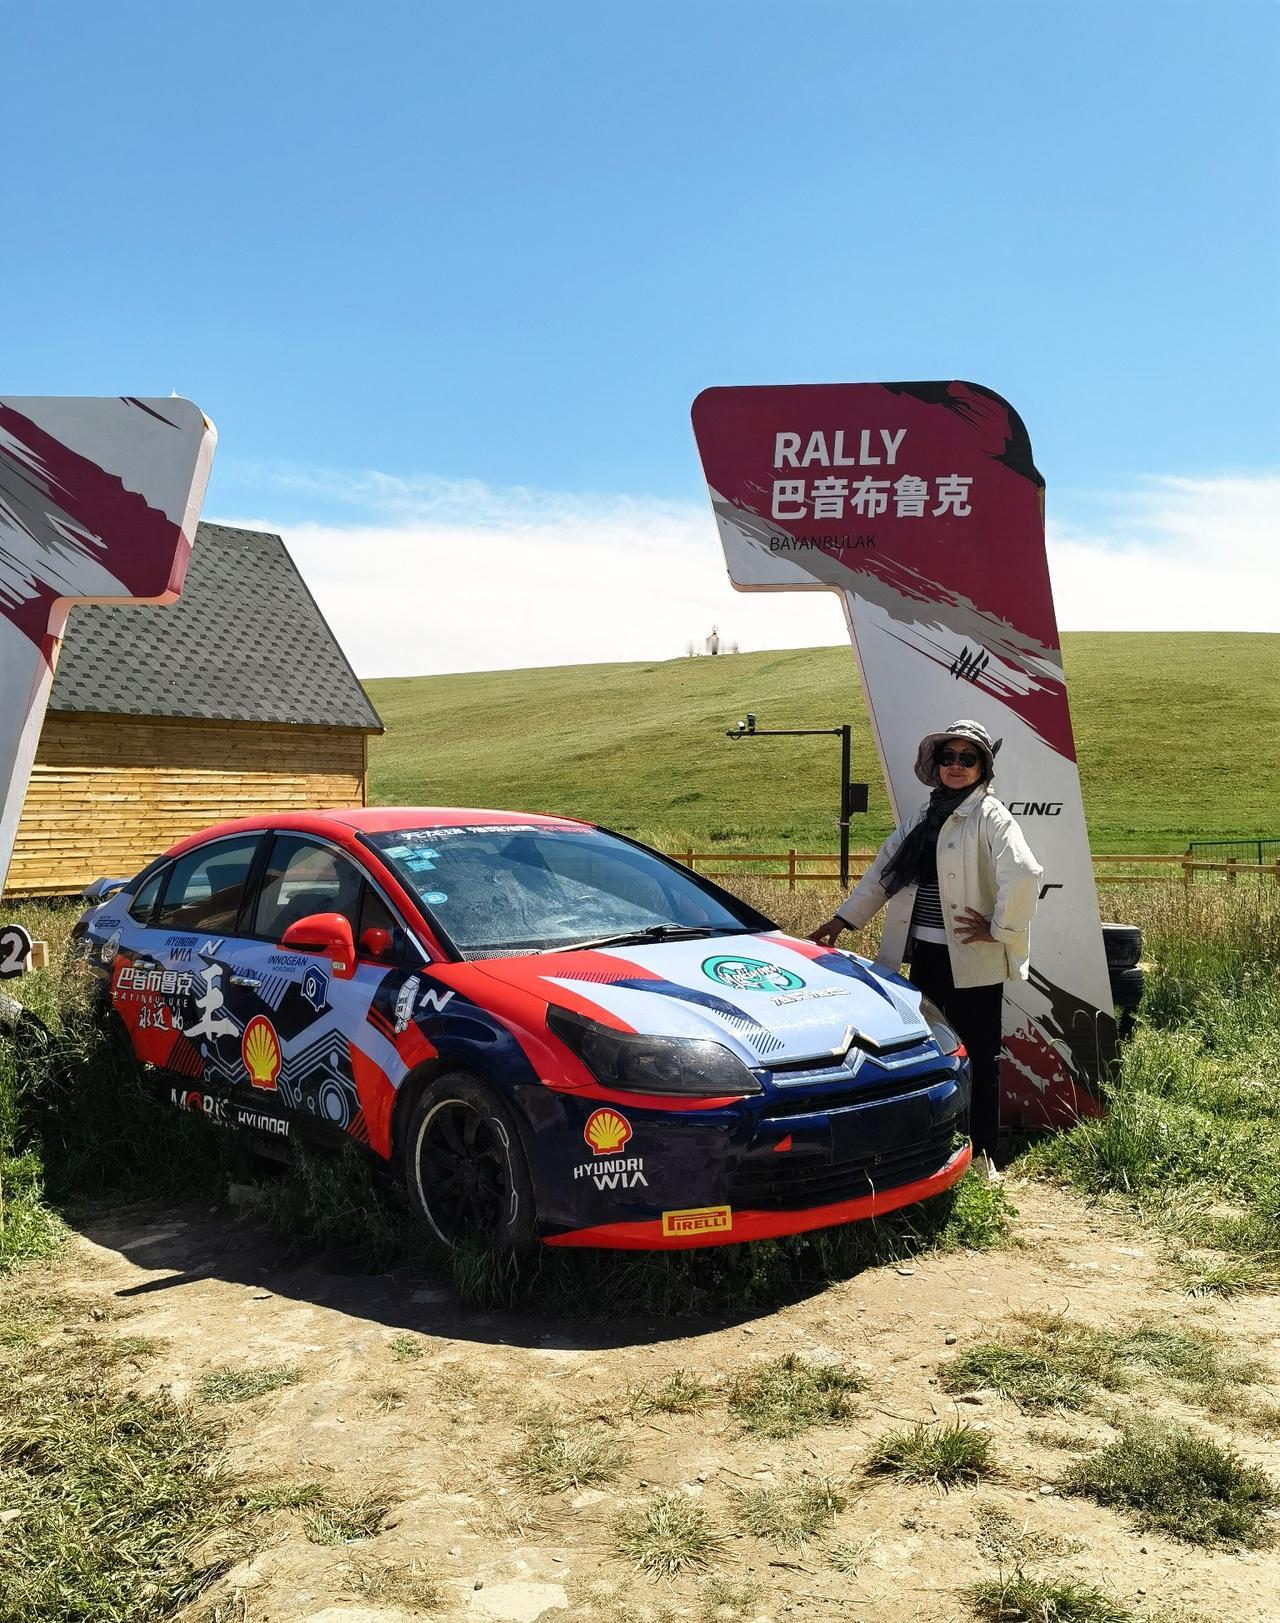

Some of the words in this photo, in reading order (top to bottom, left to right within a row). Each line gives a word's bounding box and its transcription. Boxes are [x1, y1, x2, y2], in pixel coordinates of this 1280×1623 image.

[774, 429, 908, 468] RALLY
[771, 474, 974, 520] 巴音布鲁克
[770, 535, 877, 551] BAYANBULAK
[1001, 802, 1064, 816] CING
[170, 947, 192, 962] WIA
[116, 967, 194, 996] 巴音布鲁克
[113, 991, 188, 1008] AYINBULUKE
[238, 1111, 290, 1136] HYUNDAI
[593, 1171, 649, 1191] WIA
[667, 1211, 728, 1232] PIRELLI
